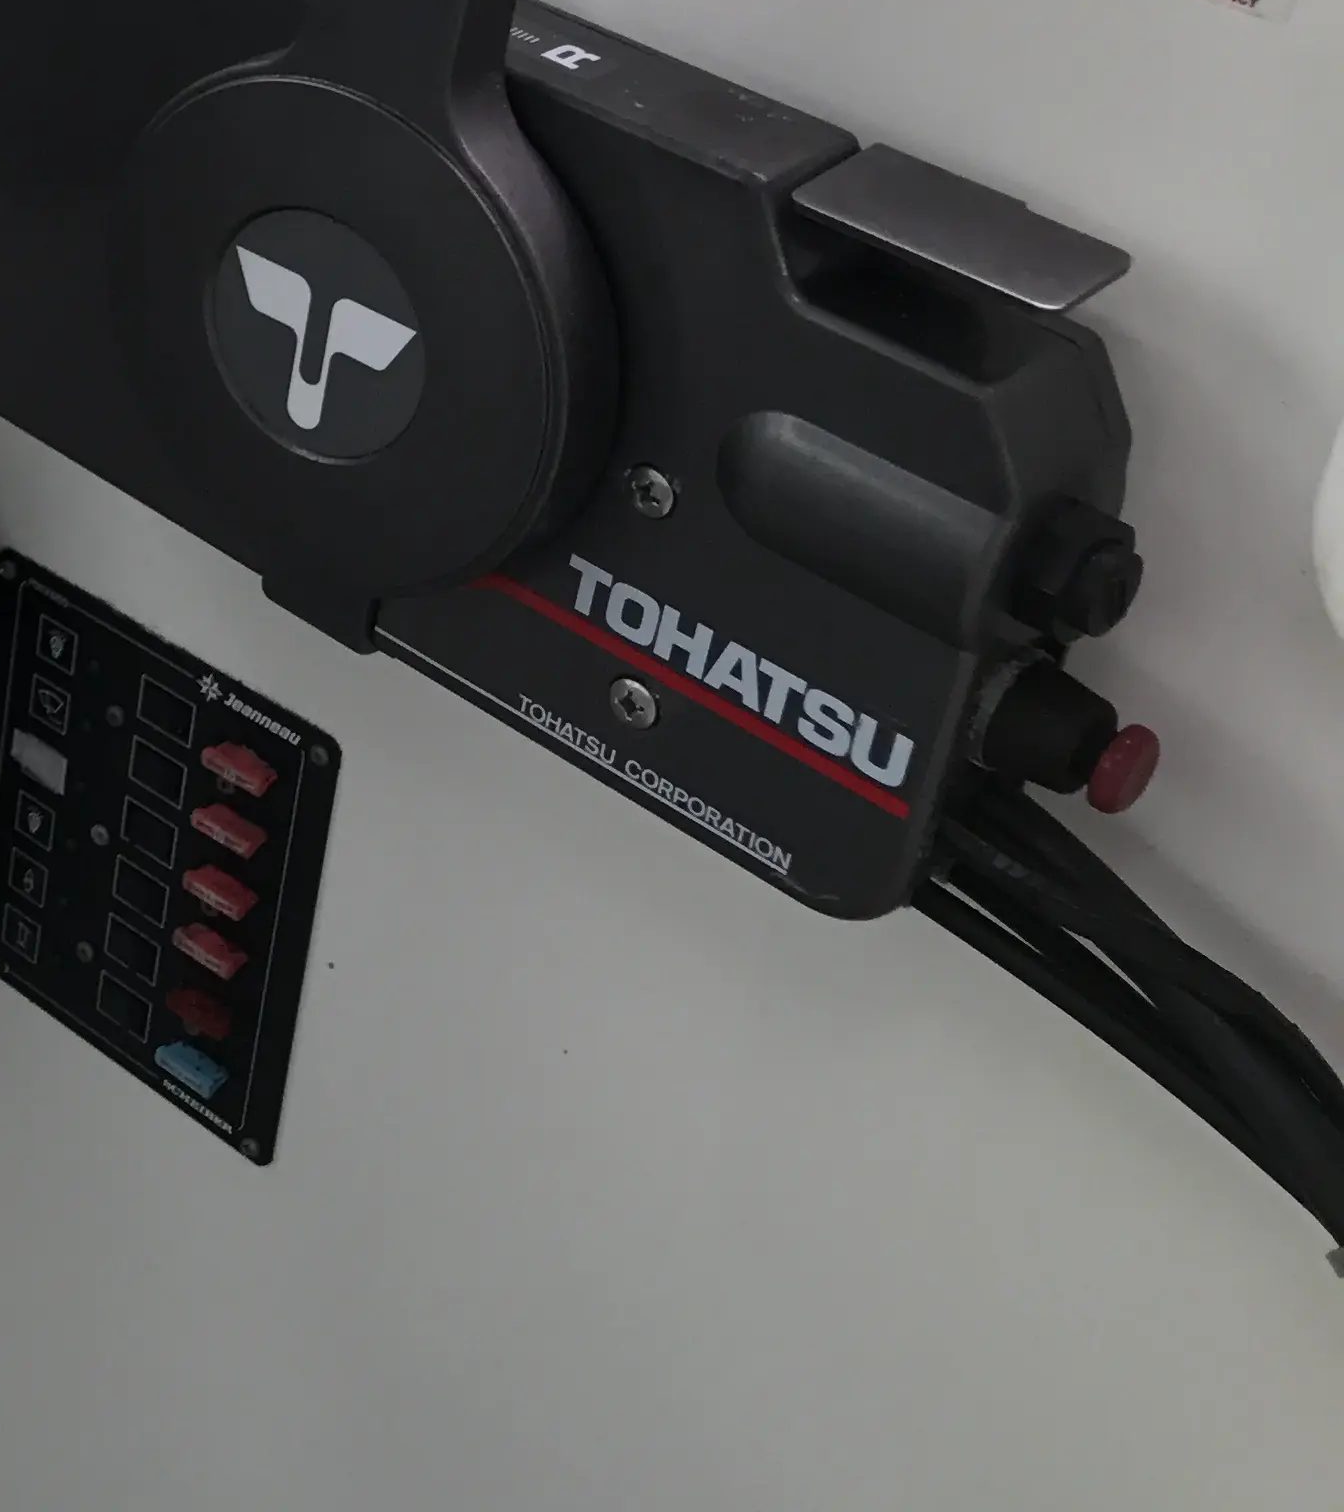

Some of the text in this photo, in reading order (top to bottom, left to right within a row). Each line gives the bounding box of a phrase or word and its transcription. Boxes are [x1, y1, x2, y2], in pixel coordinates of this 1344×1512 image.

[224, 692, 302, 746] Jeanneau
[569, 553, 915, 789] TOHATSU
[517, 693, 793, 870] TOHATSU CORPORATION
